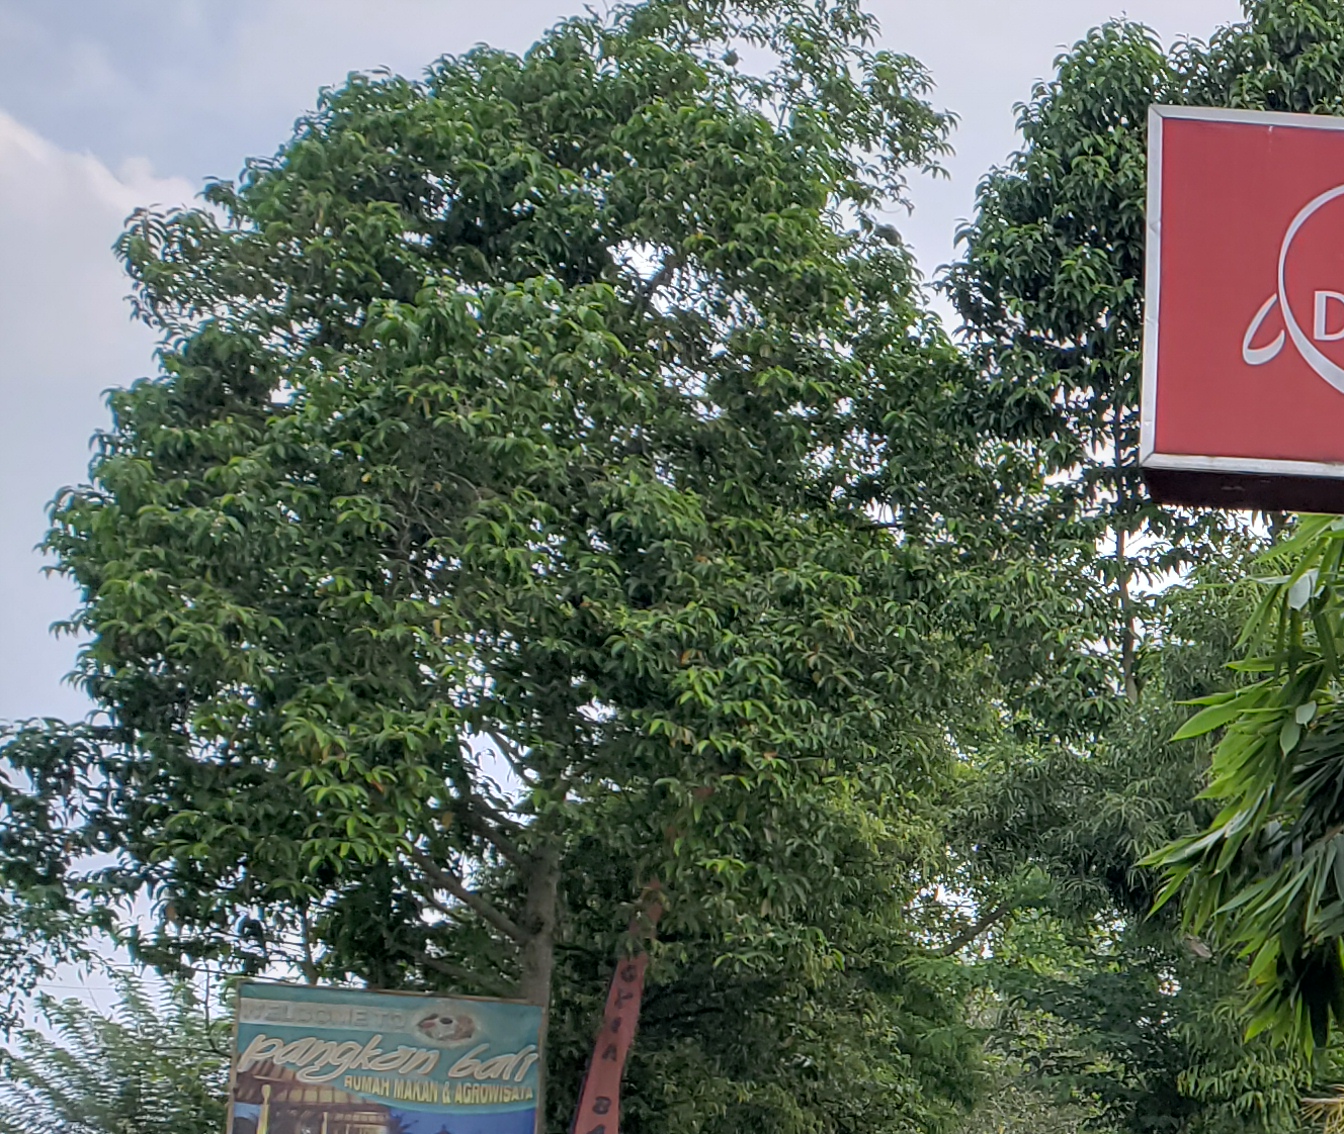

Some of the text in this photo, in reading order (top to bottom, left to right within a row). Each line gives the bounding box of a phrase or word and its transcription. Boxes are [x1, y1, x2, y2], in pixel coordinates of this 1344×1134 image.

[242, 1004, 406, 1029] WELCOME TO
[447, 1043, 539, 1082] bali
[344, 1074, 533, 1105] RUMAH MAKAN & AGROWISATA
